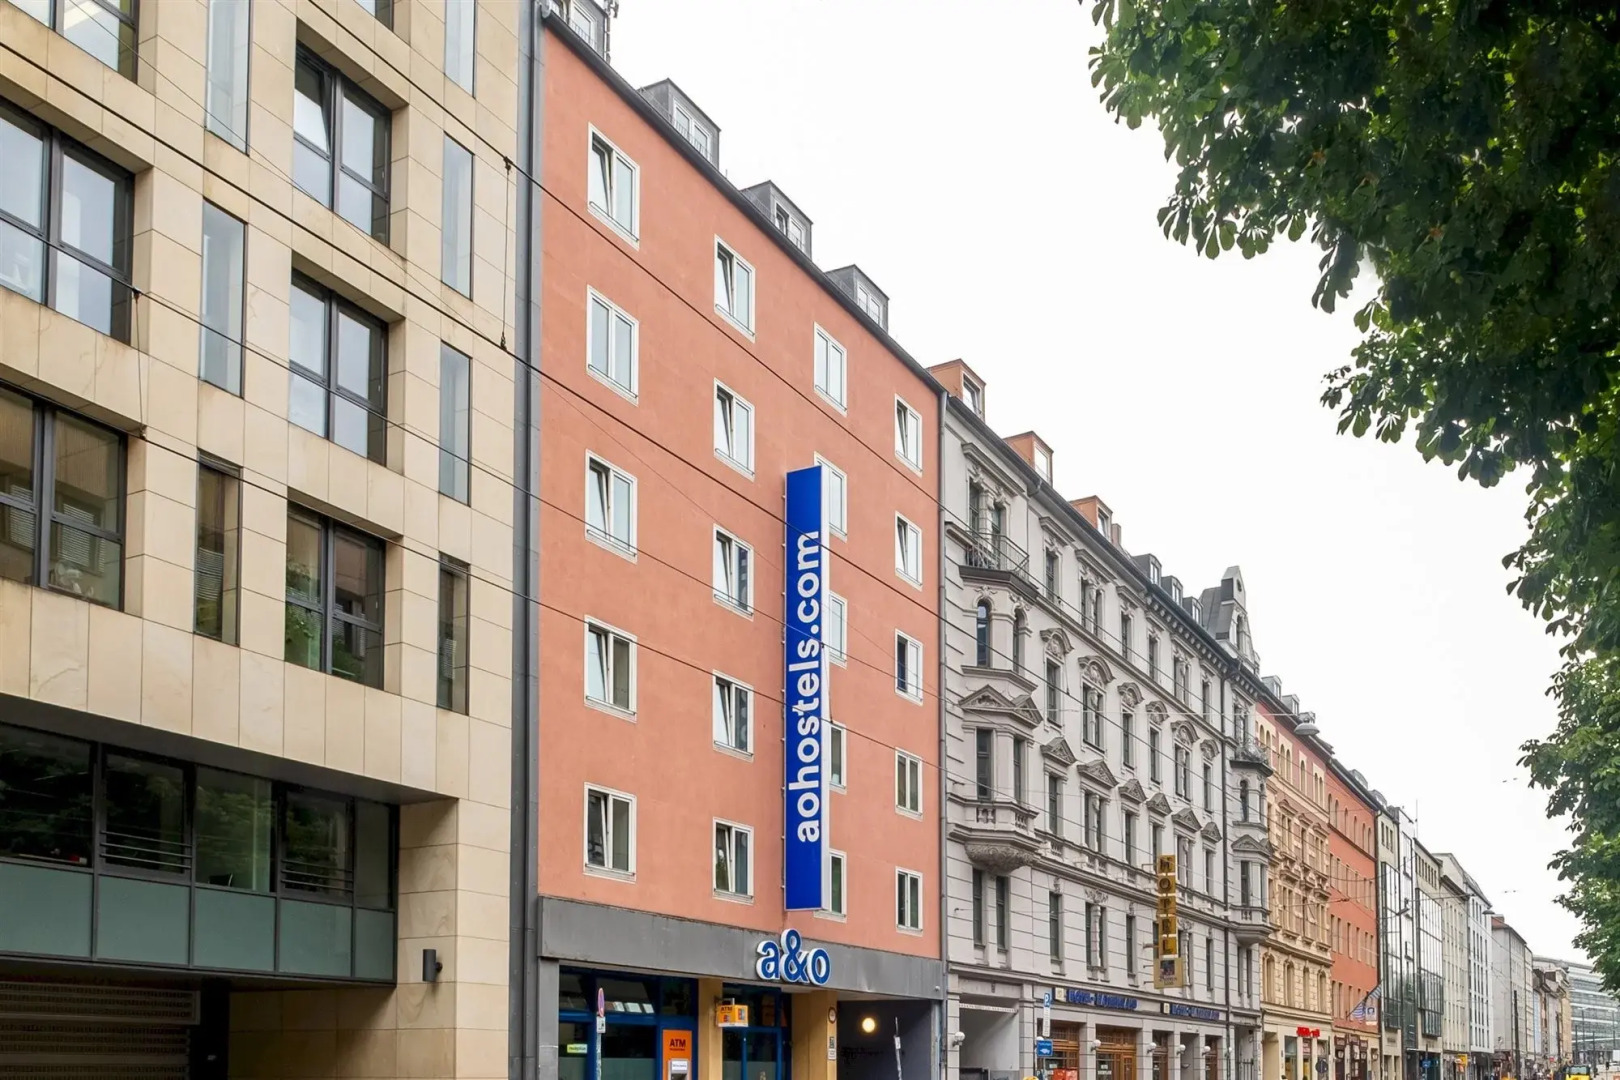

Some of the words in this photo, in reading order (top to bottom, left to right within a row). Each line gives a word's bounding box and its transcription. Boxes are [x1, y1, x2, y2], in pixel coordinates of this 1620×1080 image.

[788, 530, 820, 843] aohostels.com
[756, 928, 831, 985] a&o
[669, 1038, 686, 1048] ATM
